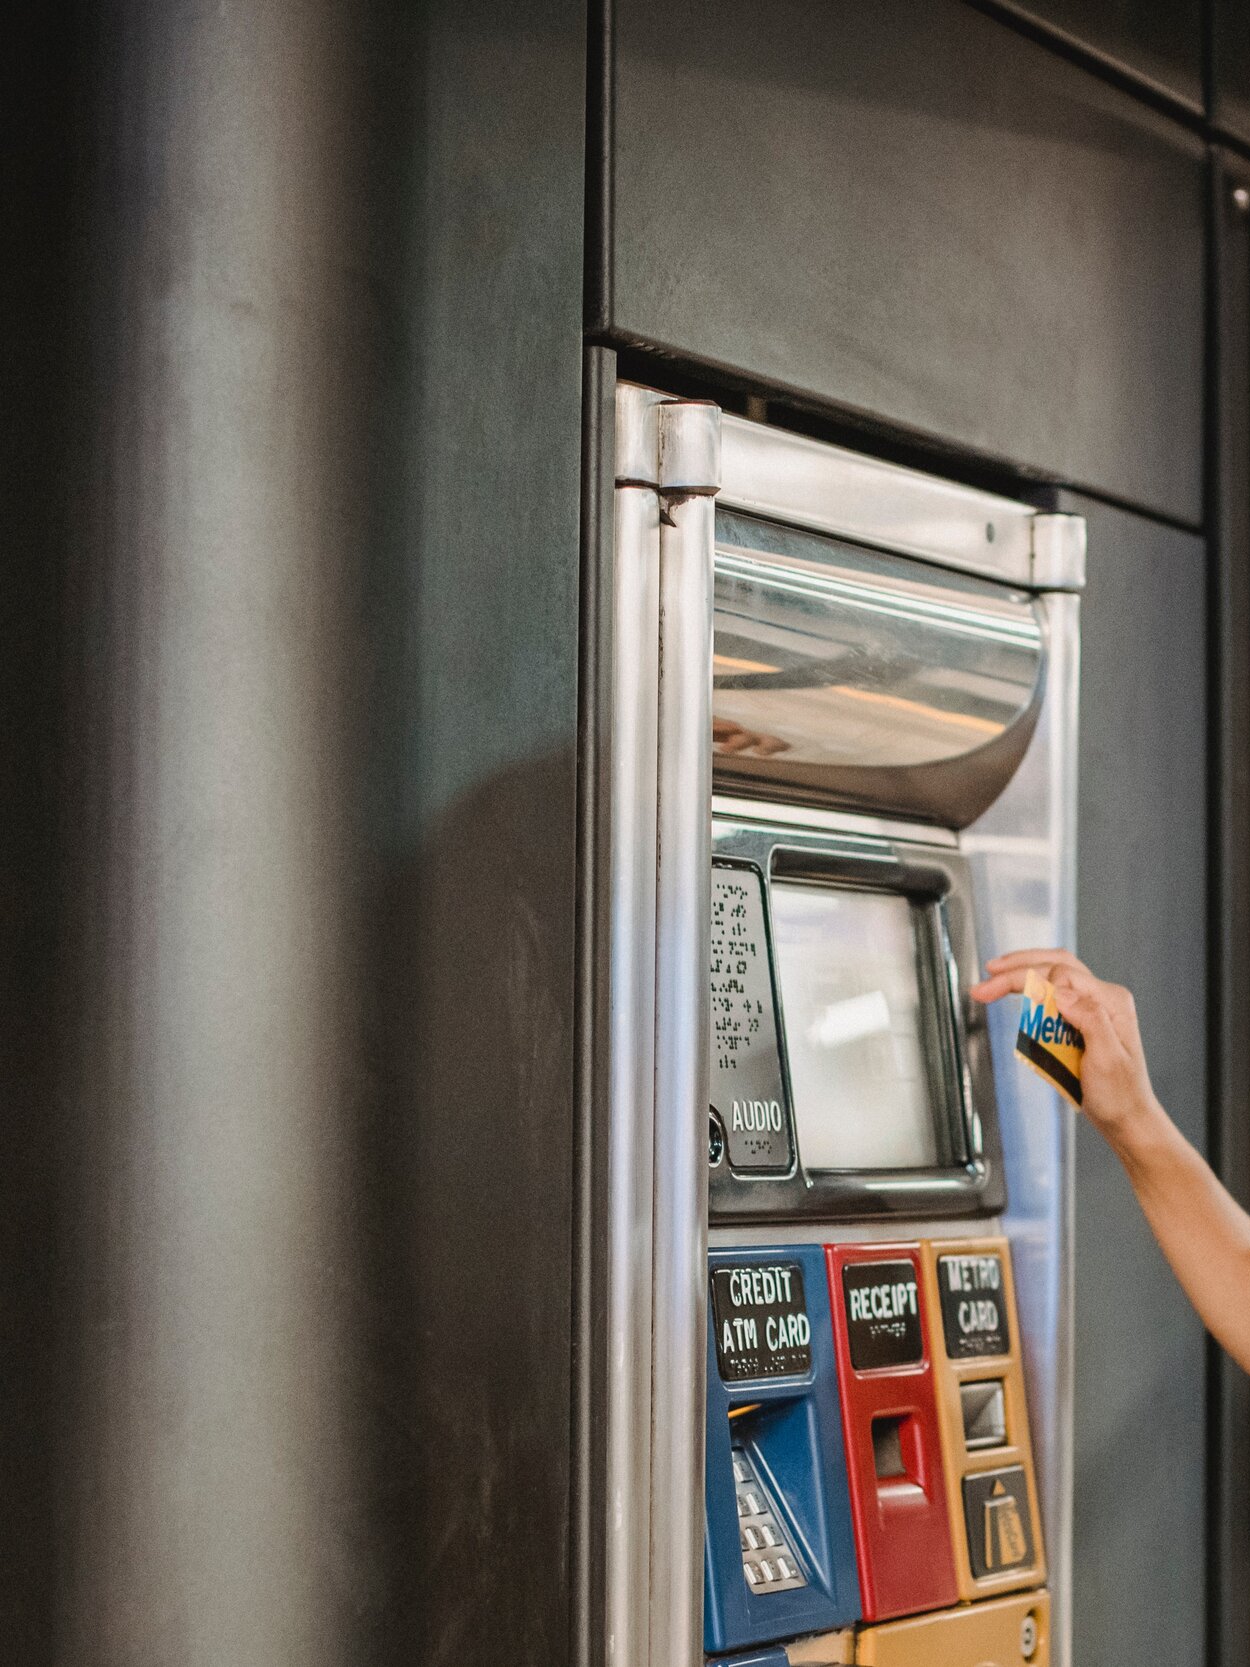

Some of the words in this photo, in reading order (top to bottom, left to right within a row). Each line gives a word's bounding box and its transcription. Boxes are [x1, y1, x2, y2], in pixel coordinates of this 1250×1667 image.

[732, 1099, 782, 1132] AUDIO
[729, 1269, 792, 1307] CREDIT
[947, 1257, 1000, 1292] METRO
[850, 1281, 918, 1322] RECEIPT
[958, 1300, 999, 1334] CARD
[723, 1317, 758, 1354] ATM
[766, 1313, 811, 1352] CARD
